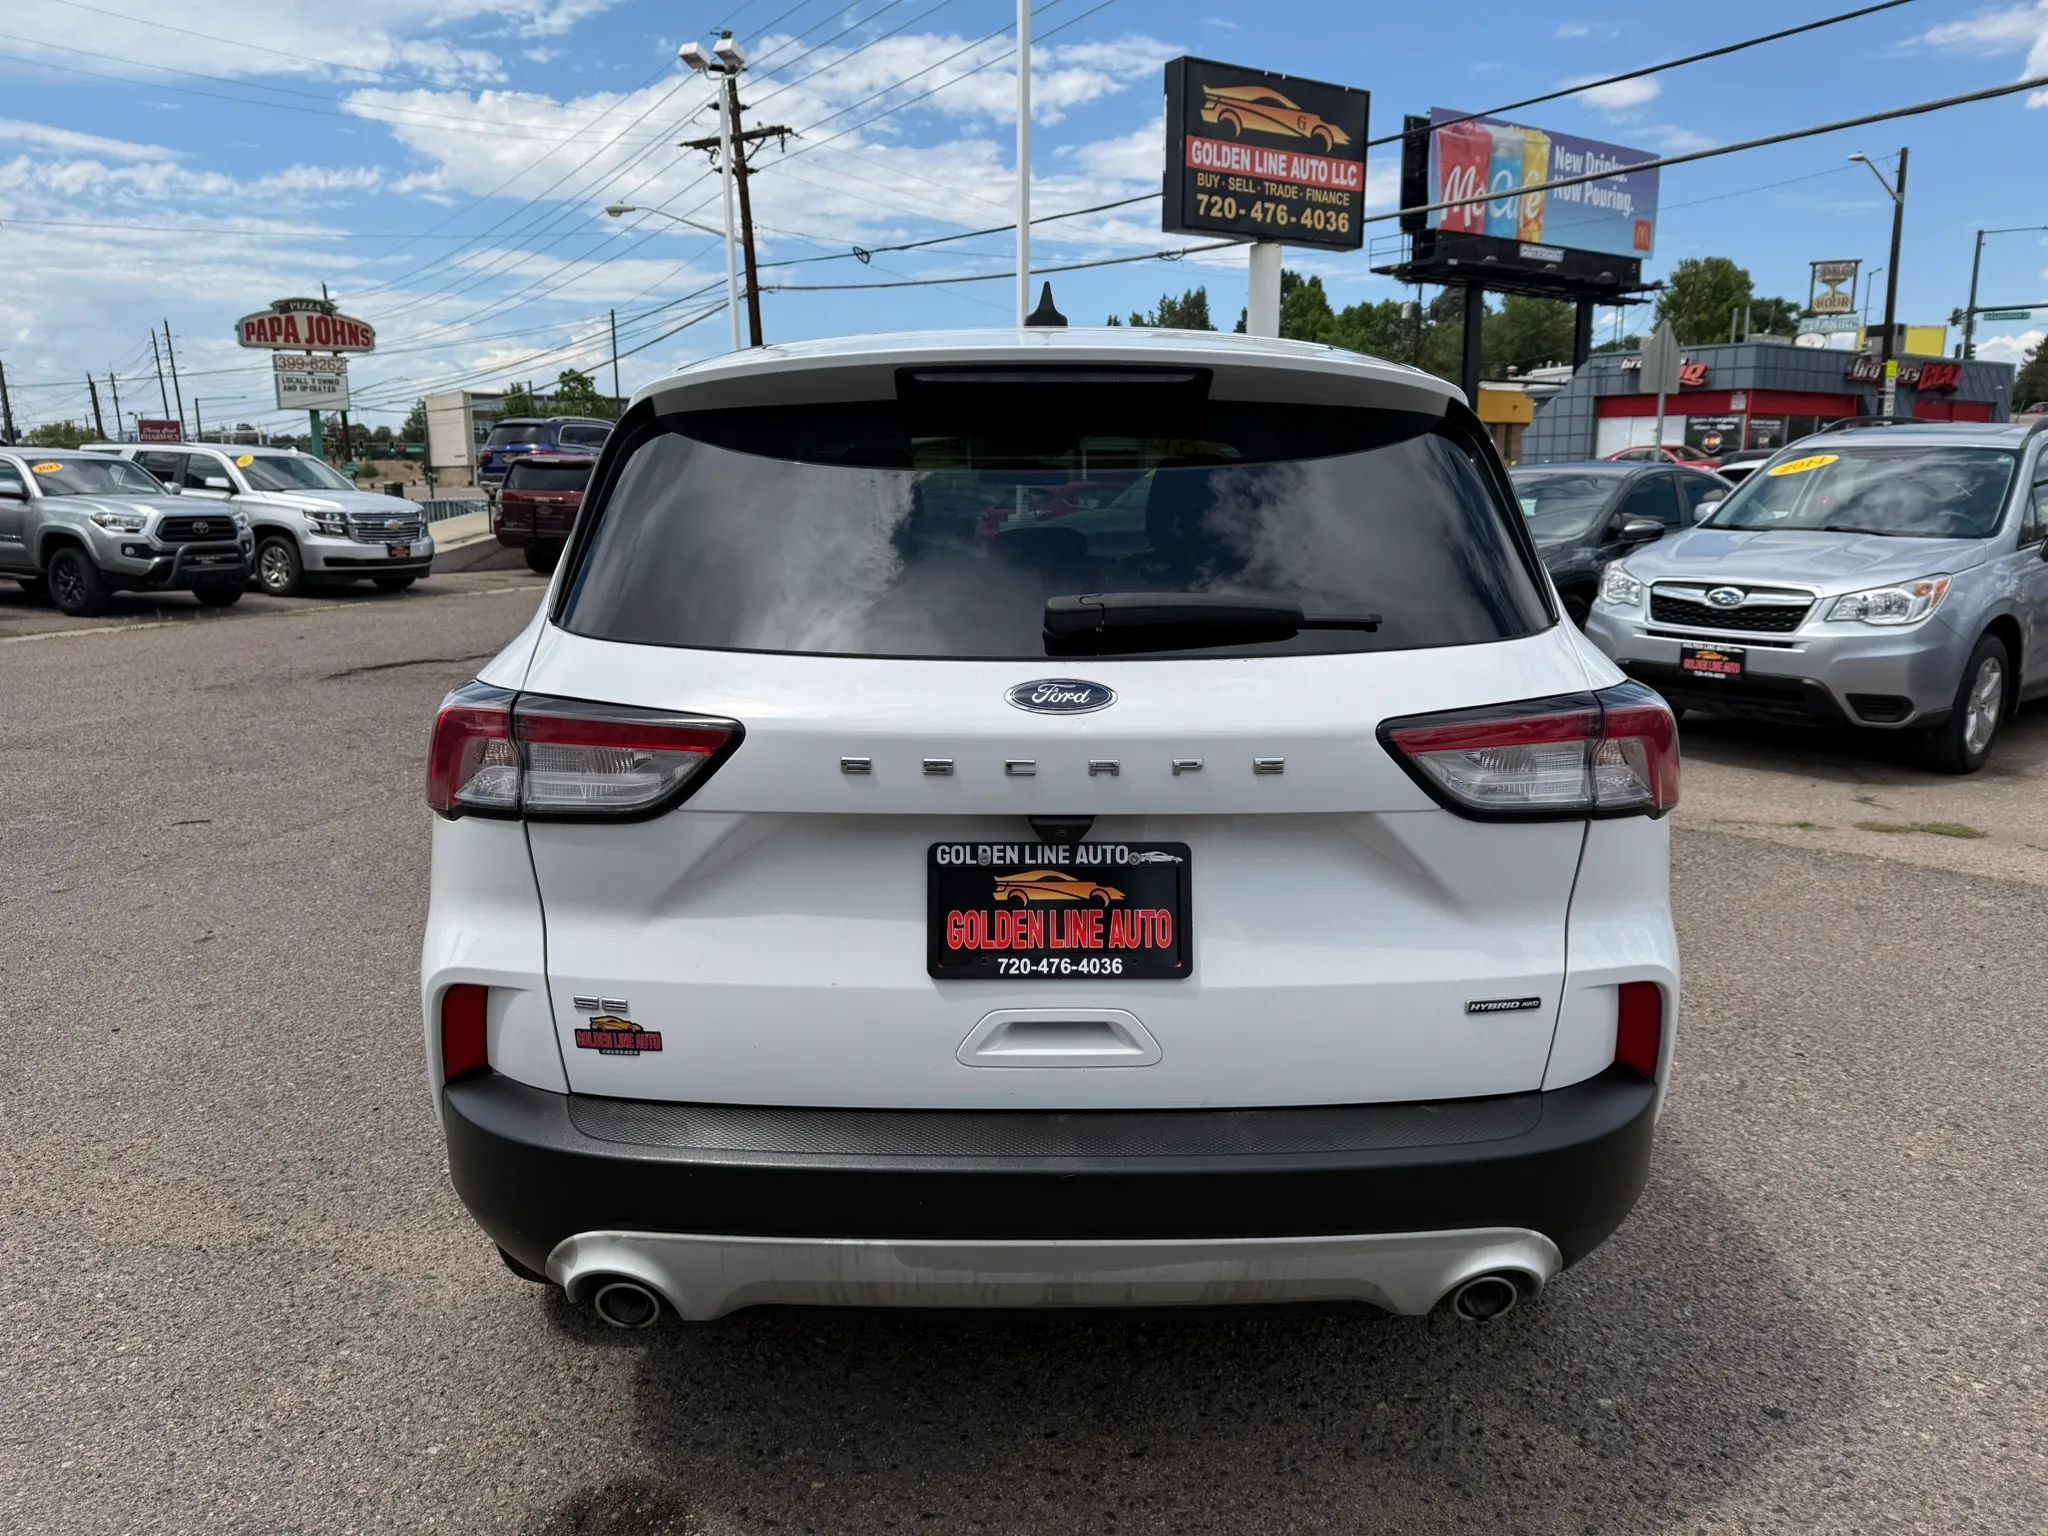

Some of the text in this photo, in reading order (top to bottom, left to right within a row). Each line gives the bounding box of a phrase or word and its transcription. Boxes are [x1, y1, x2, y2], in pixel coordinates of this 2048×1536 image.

[1191, 140, 1358, 187] GOLDEN LINE AUTO LLC
[1554, 144, 1584, 173] New
[1196, 172, 1350, 207] BUY SELL TRADE FINANCE
[1553, 174, 1634, 219] Now Pouring.
[289, 301, 321, 311] PIZZA
[1816, 296, 1850, 309] HOUR
[244, 315, 301, 344] PAPA
[278, 356, 344, 371] 399-6262
[283, 384, 297, 392] AND
[1031, 682, 1091, 705] Ford
[840, 756, 1286, 777] ESCAPE
[936, 845, 1129, 866] GOLDEN LINE AUTO
[947, 908, 1173, 950] GOLDEN LINE AUTO
[997, 957, 1123, 975] 720-476-4036
[1469, 1000, 1539, 1011] HYBRID AWD
[576, 1031, 661, 1050] GOLDEN LINE AUTO
